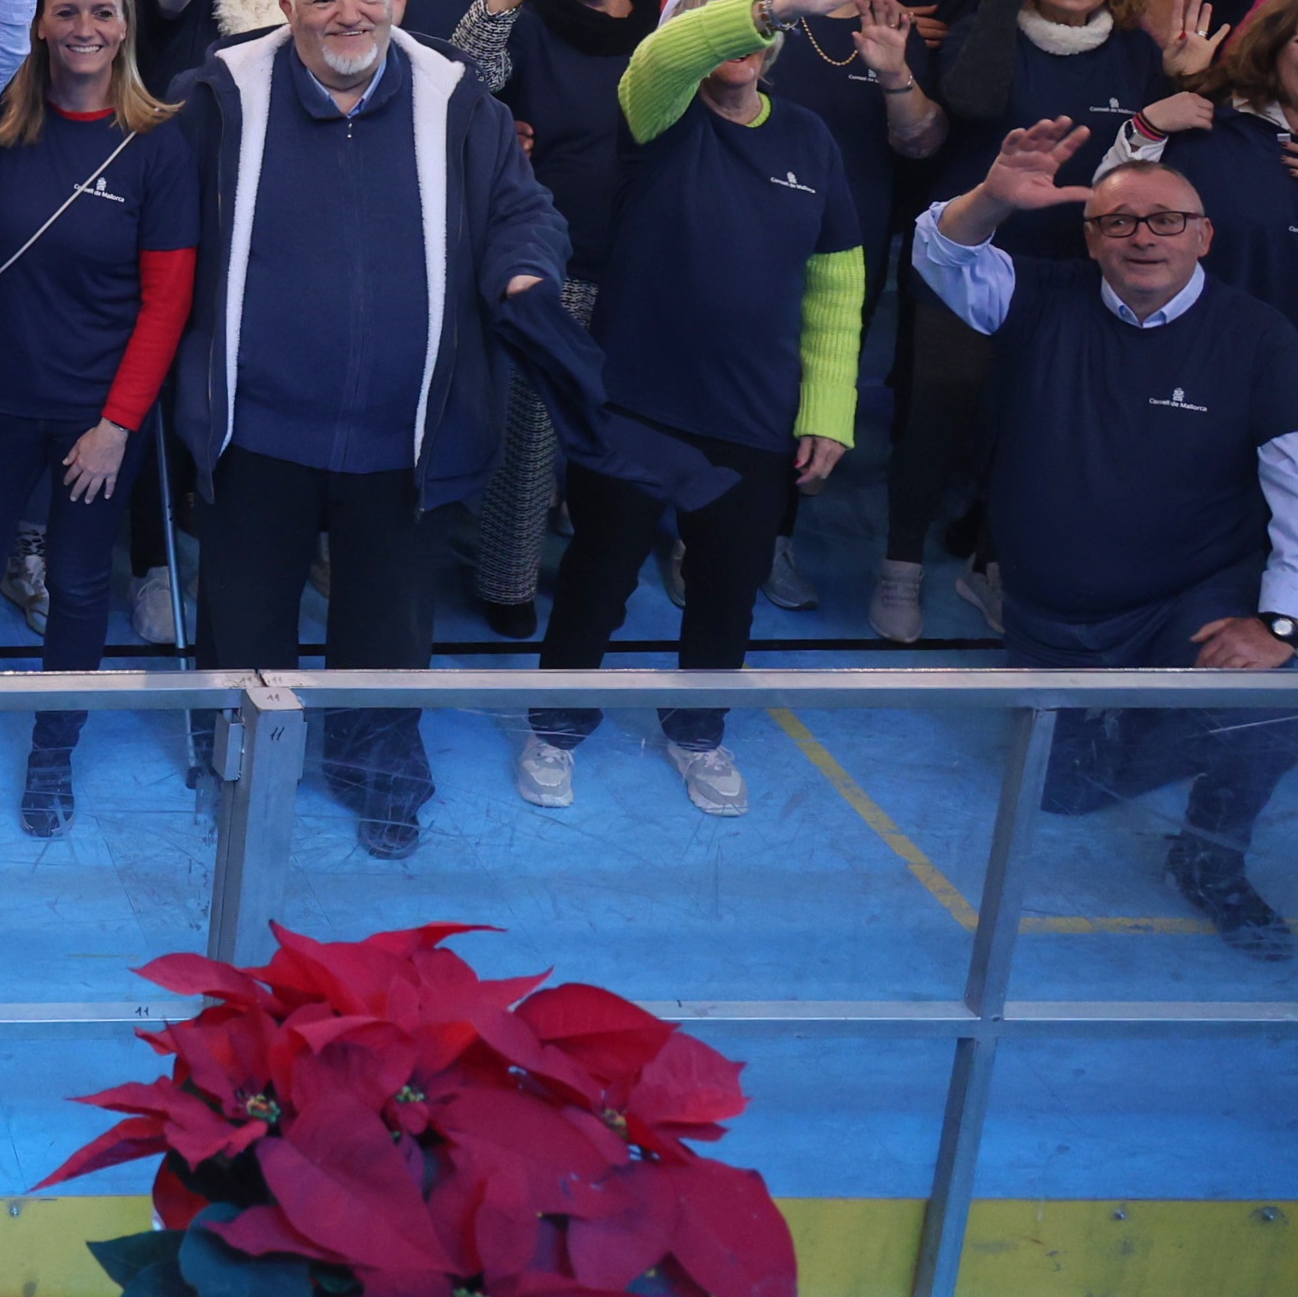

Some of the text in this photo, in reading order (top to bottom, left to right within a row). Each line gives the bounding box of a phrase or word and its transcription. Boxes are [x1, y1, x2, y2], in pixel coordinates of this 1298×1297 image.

[93, 189, 102, 197] de
[101, 190, 125, 203] Mallorca
[1179, 401, 1209, 412] Mallorca
